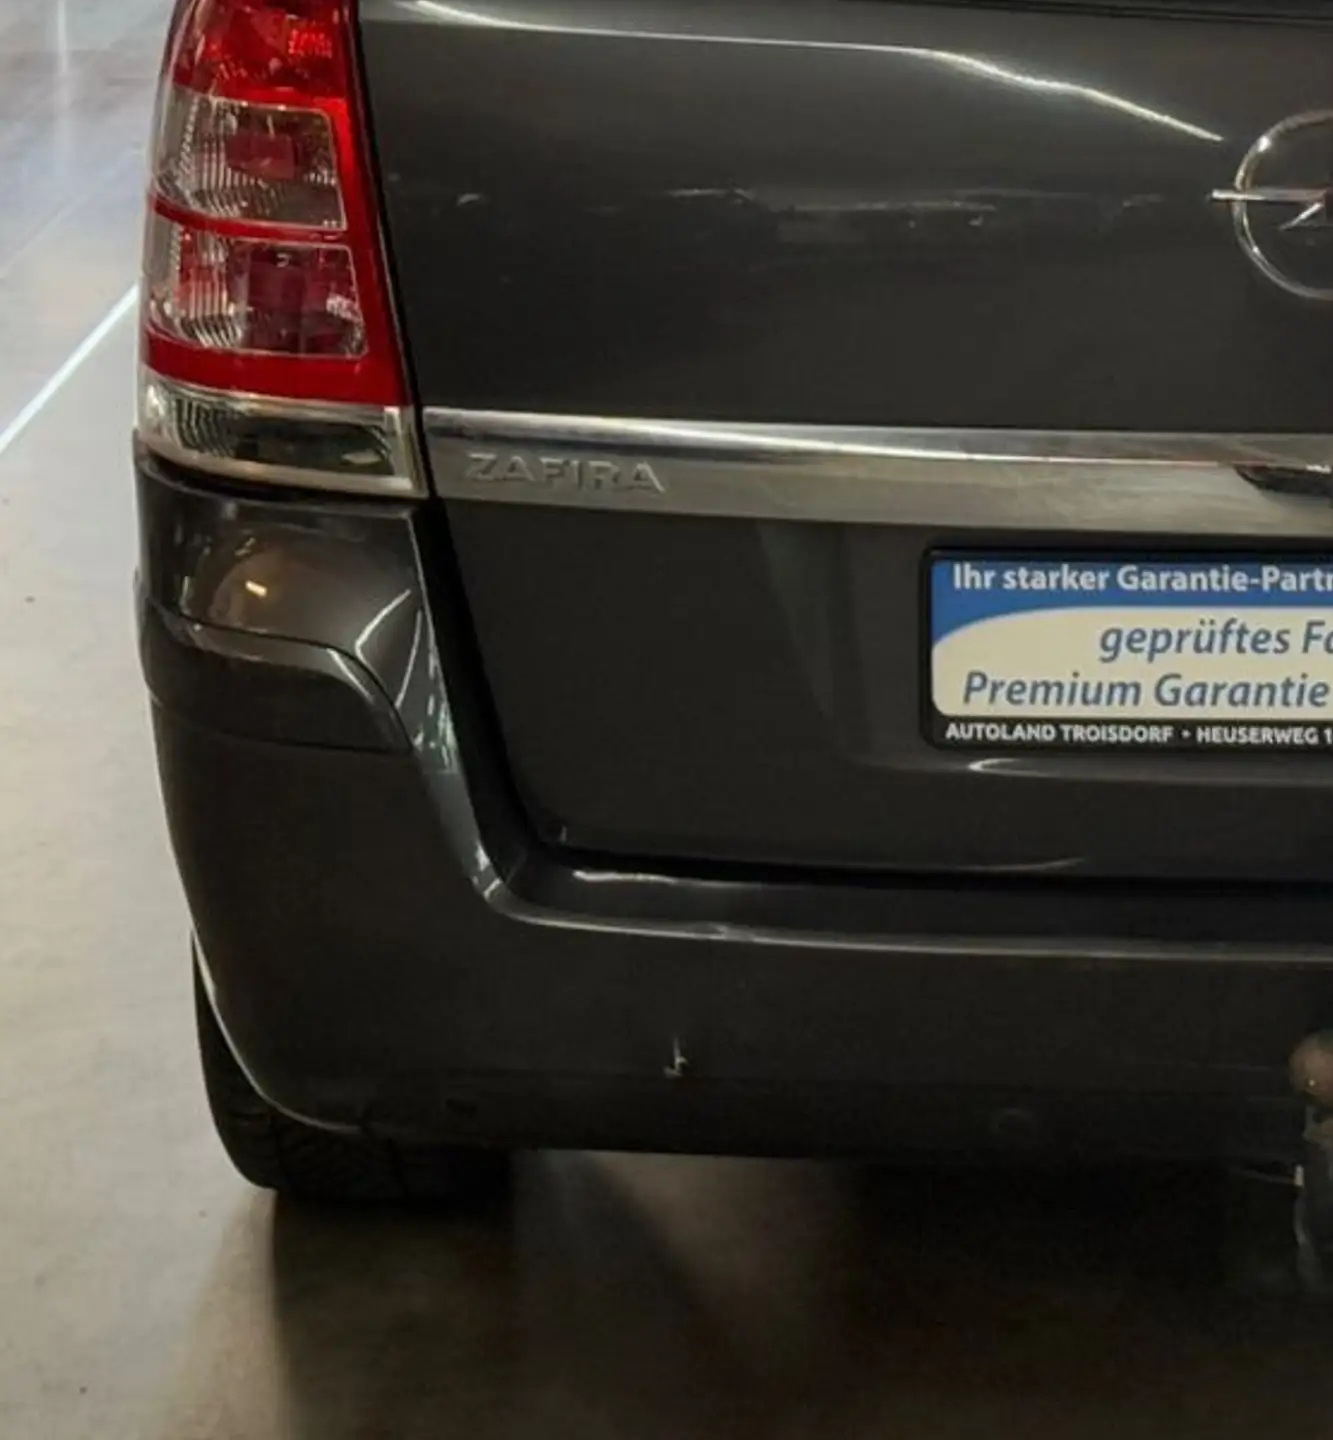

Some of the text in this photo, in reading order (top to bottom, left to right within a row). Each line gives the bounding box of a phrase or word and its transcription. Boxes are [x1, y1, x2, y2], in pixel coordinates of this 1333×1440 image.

[467, 452, 665, 493] ZAFIRA
[953, 563, 996, 590] Ihr
[1002, 564, 1110, 591] starker
[1099, 618, 1291, 663] geprüftes
[963, 670, 1331, 708] Premium Garantie
[945, 723, 1057, 741] AUTOLAND
[1060, 724, 1173, 743] TROISDORF
[1196, 726, 1319, 744] HEUSERWEG
